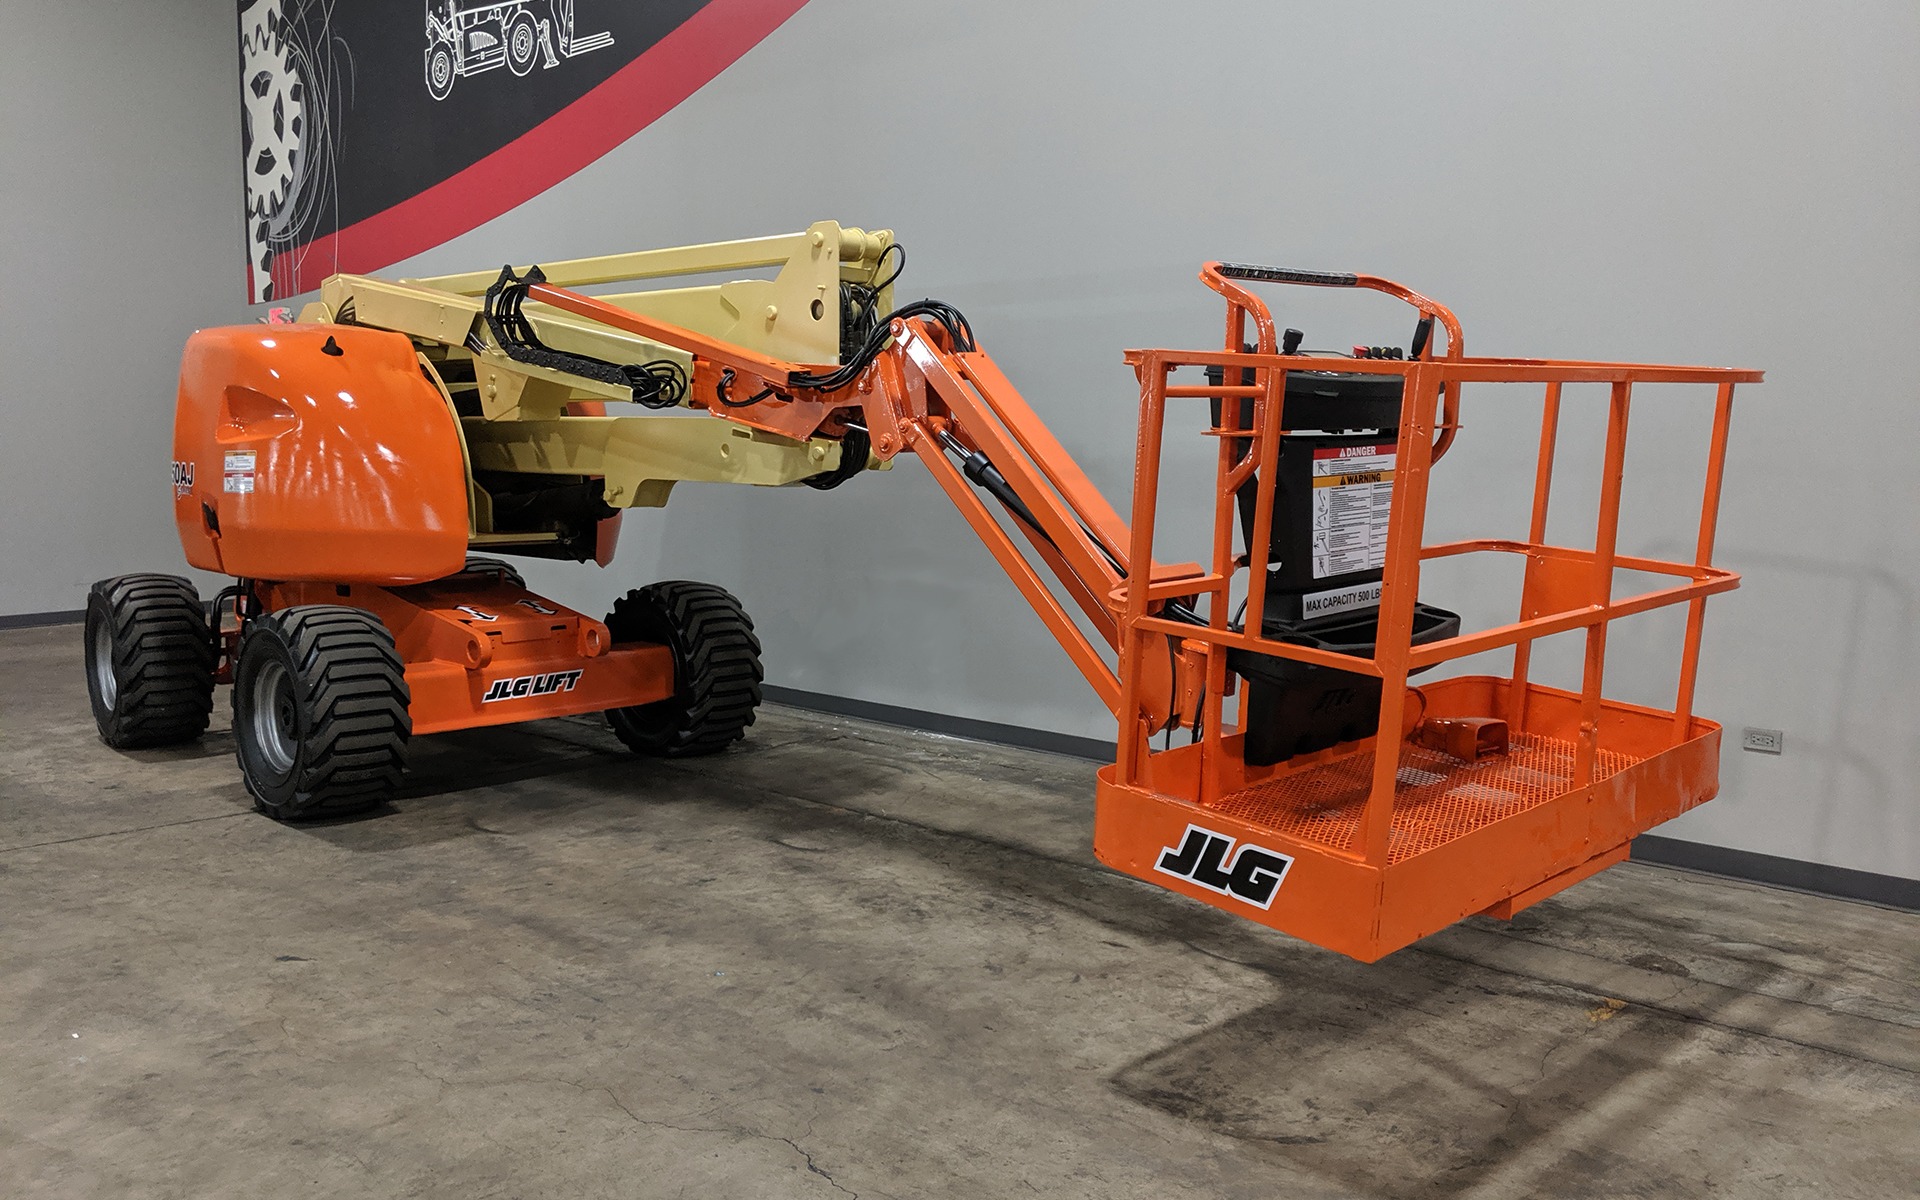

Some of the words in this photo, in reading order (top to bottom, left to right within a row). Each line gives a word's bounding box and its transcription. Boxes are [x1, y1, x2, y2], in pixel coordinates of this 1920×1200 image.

[1346, 446, 1377, 457] DANGER
[1346, 473, 1381, 485] WARNING
[1306, 598, 1322, 612] MAX
[1322, 592, 1358, 609] CAPACITY
[1358, 590, 1370, 602] 500
[484, 677, 532, 701] JLG
[531, 670, 583, 694] LIFT
[1157, 826, 1292, 908] JLG
